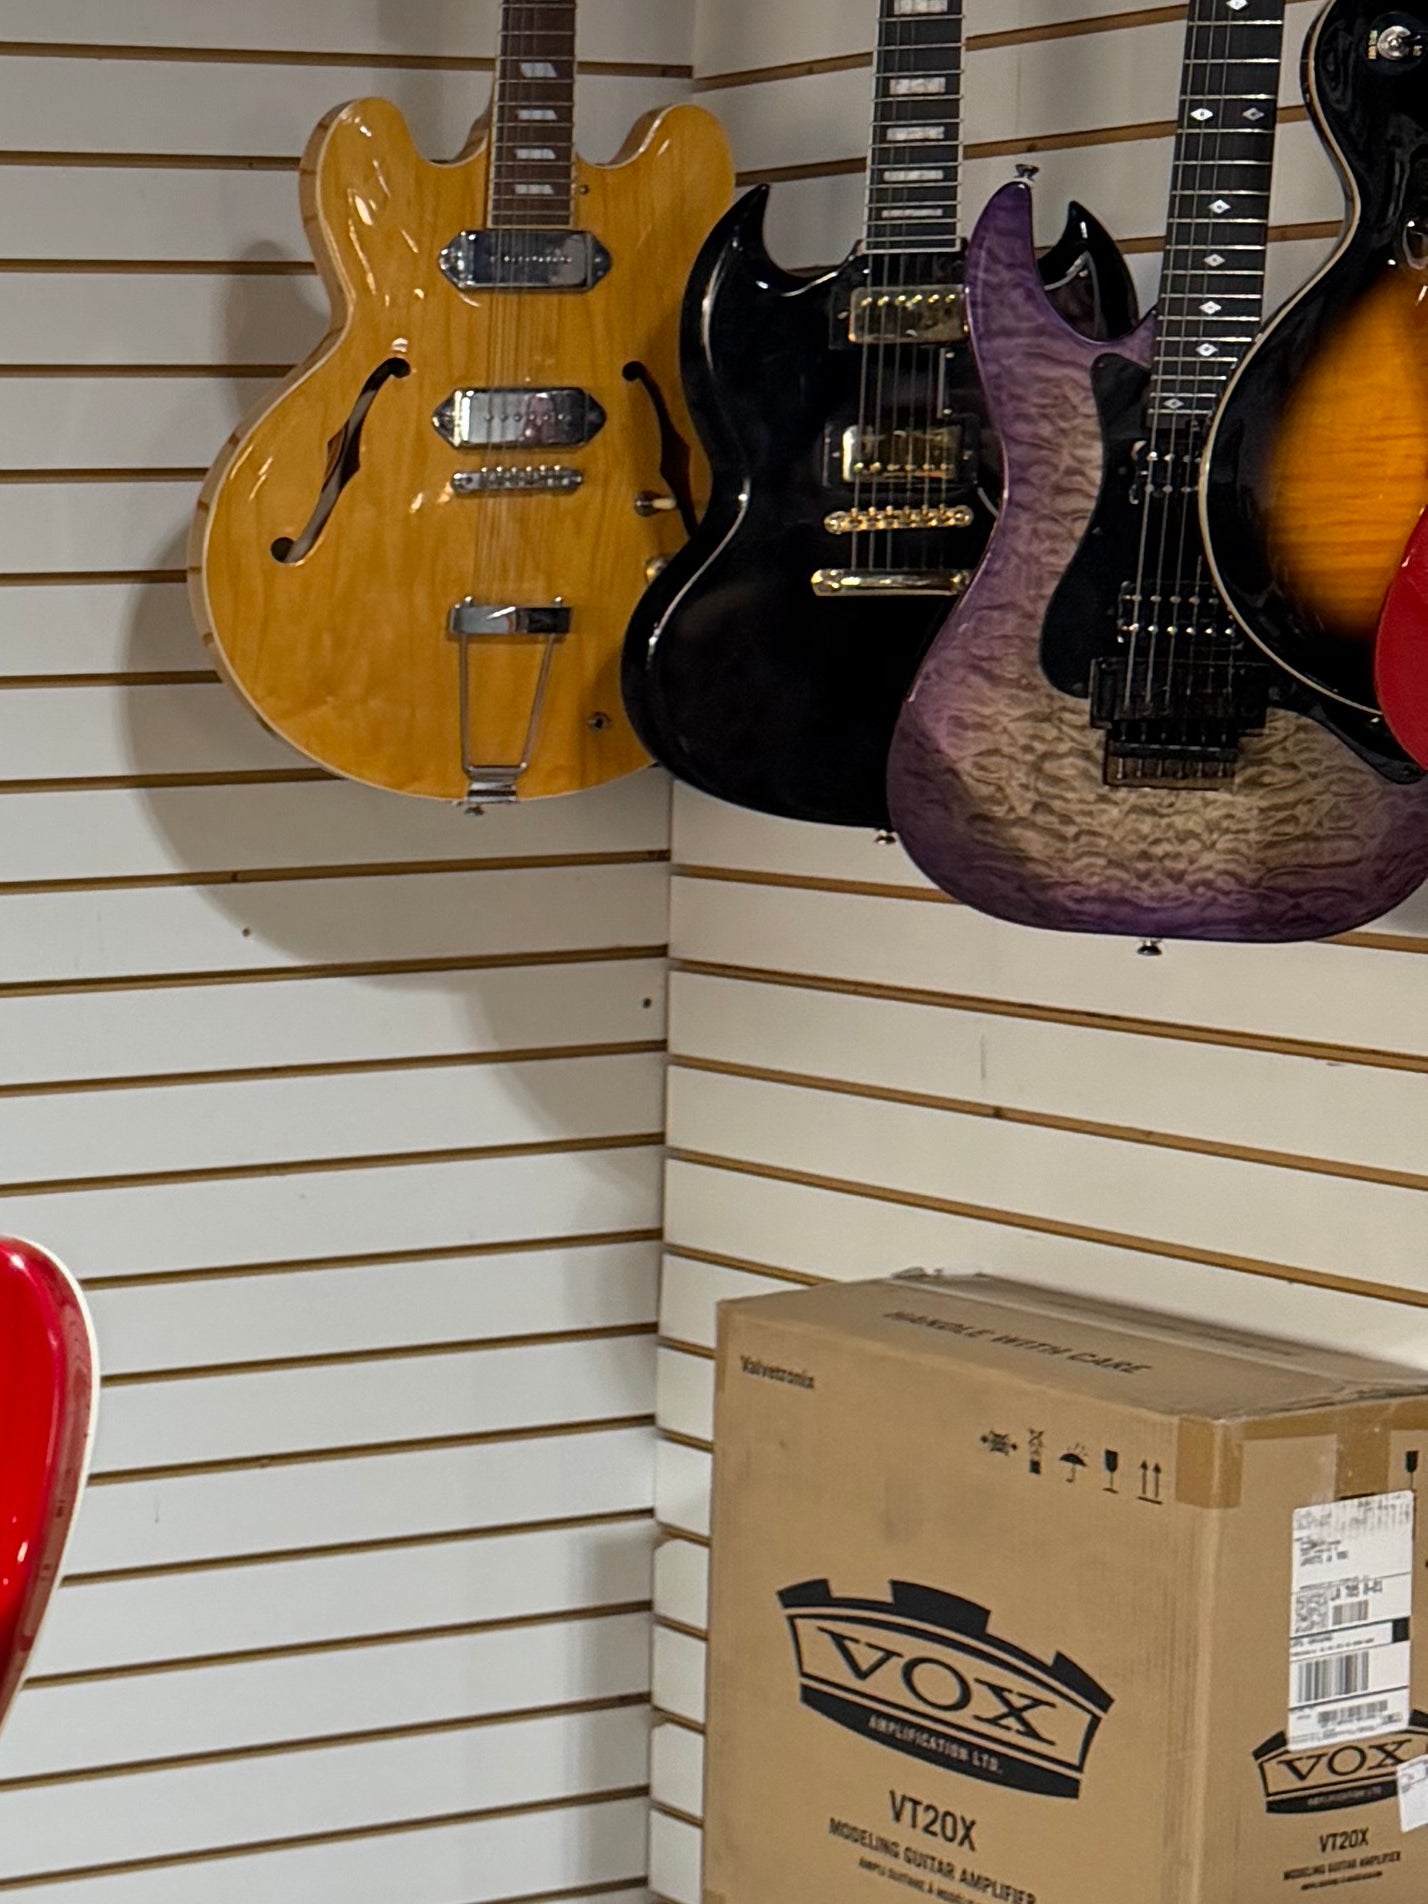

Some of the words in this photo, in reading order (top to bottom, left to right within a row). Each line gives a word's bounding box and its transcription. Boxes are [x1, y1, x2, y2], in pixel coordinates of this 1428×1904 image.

[884, 1310, 994, 1339] HANDLE
[991, 1335, 1072, 1356] WITH
[1067, 1351, 1152, 1374] CARE
[817, 1625, 1057, 1745] VOX
[868, 1713, 969, 1763] AMPLIFICATION
[1277, 1739, 1412, 1781] VOX
[829, 1817, 899, 1859] MODELING
[903, 1846, 954, 1881] GUITAR
[889, 1789, 977, 1852] VT20X
[1319, 1828, 1369, 1853] VT20X
